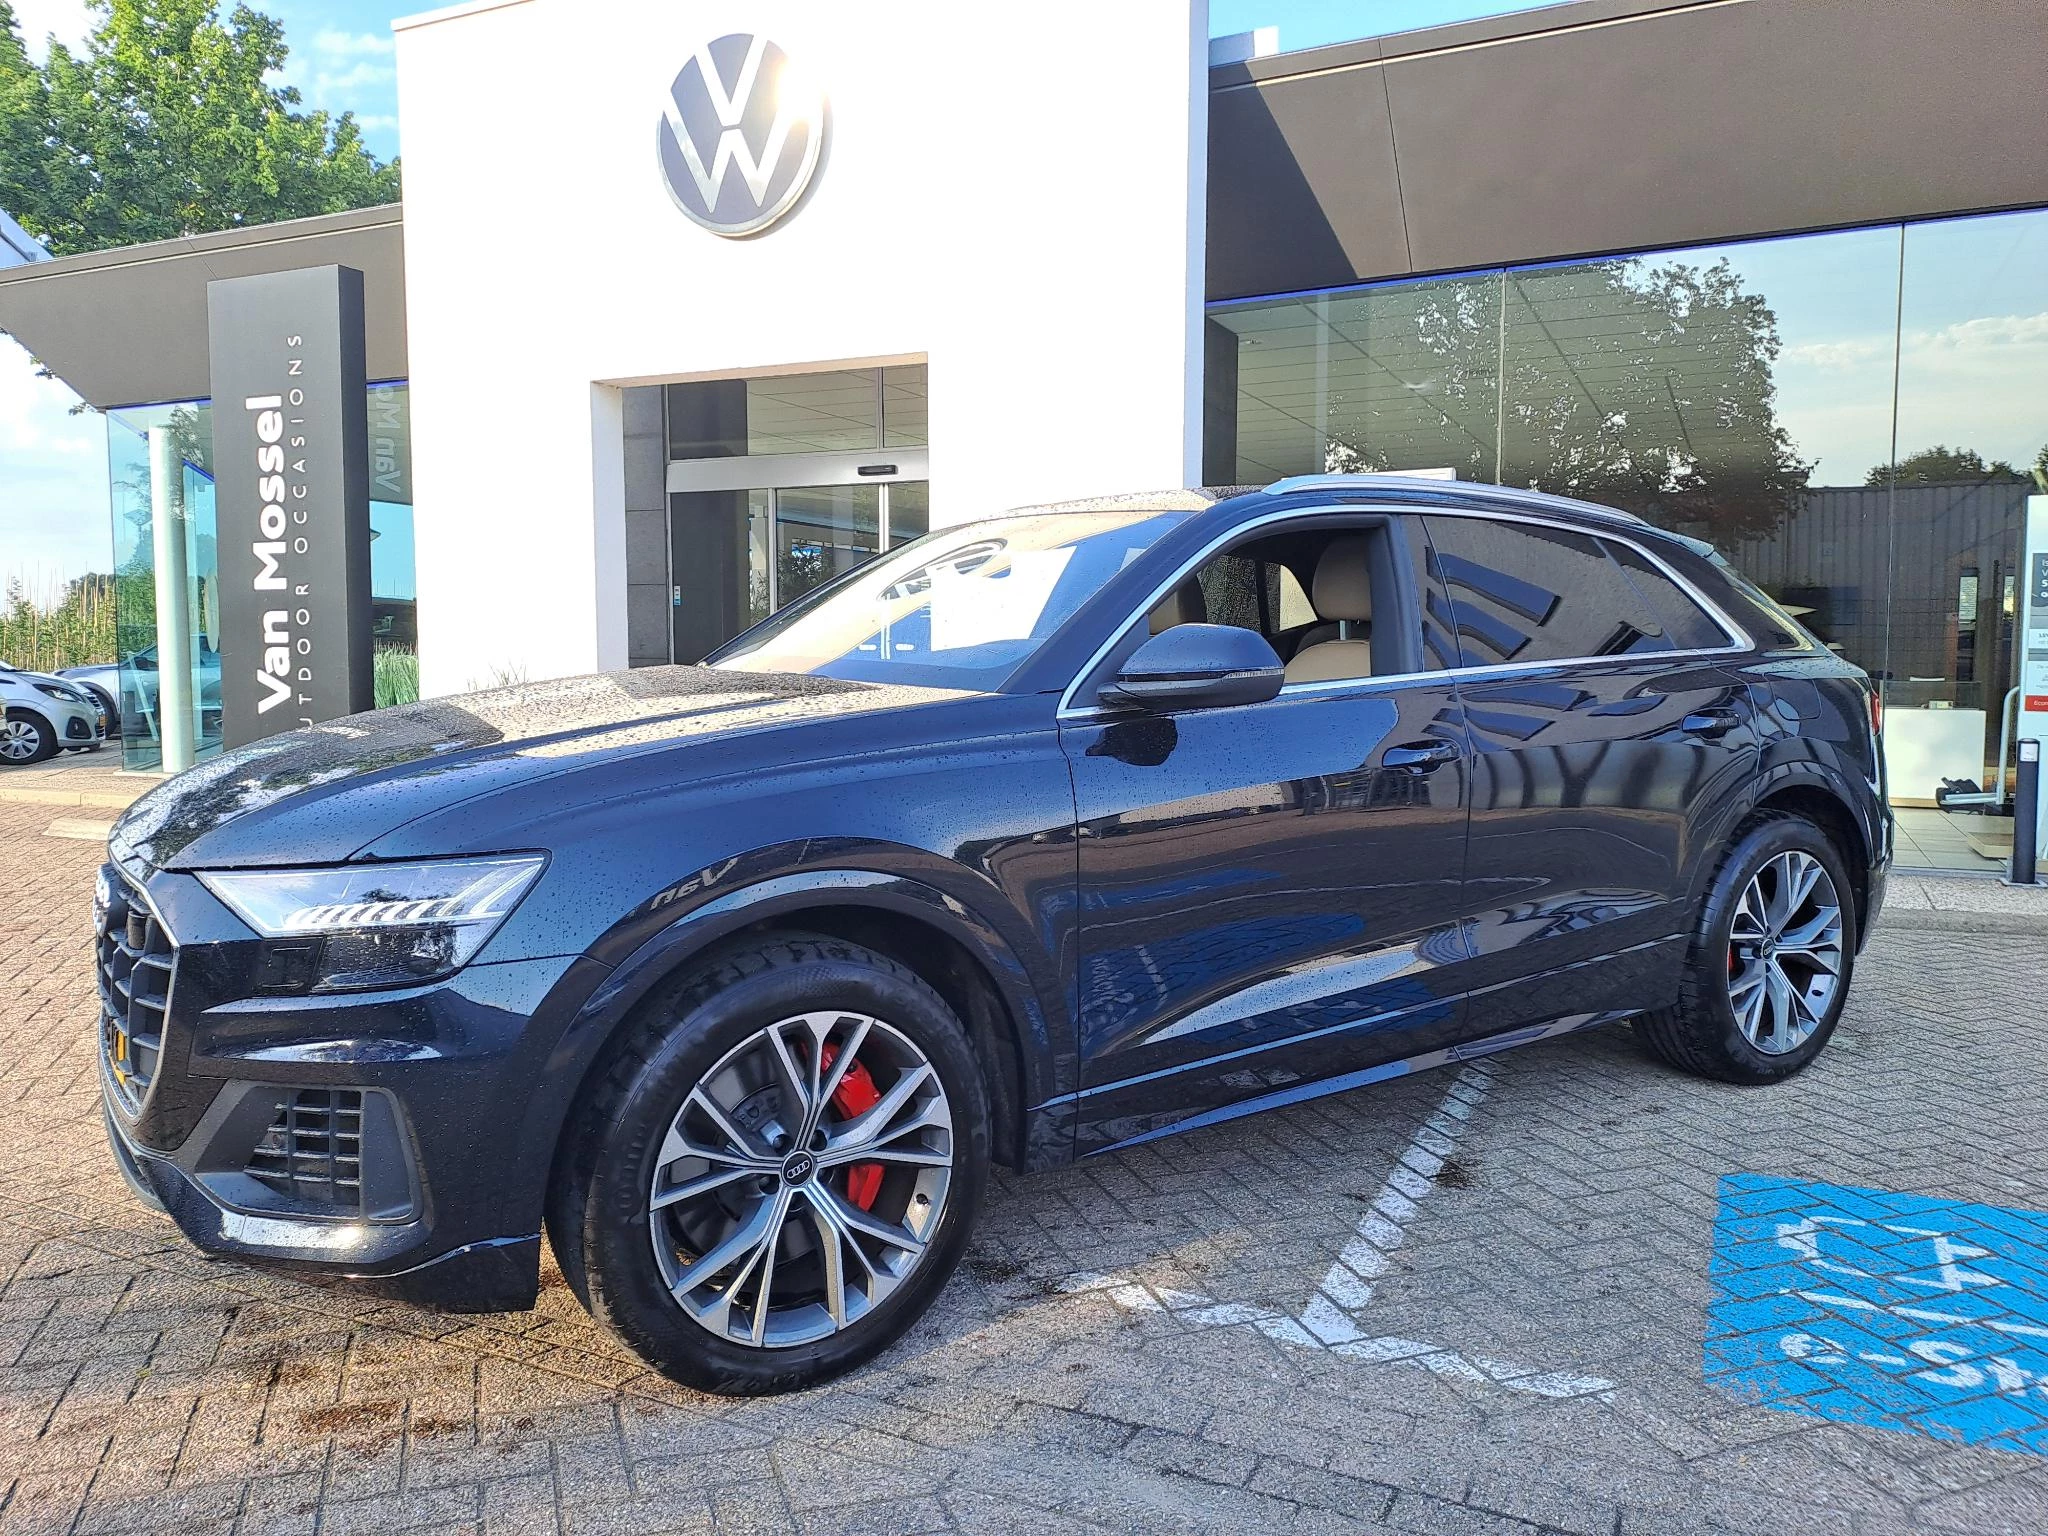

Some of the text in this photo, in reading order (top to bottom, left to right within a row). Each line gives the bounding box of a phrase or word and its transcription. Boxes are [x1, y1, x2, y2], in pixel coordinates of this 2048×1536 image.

[246, 395, 292, 714] Van Mossel
[287, 334, 313, 728] UTDOOR OCCASIONS
